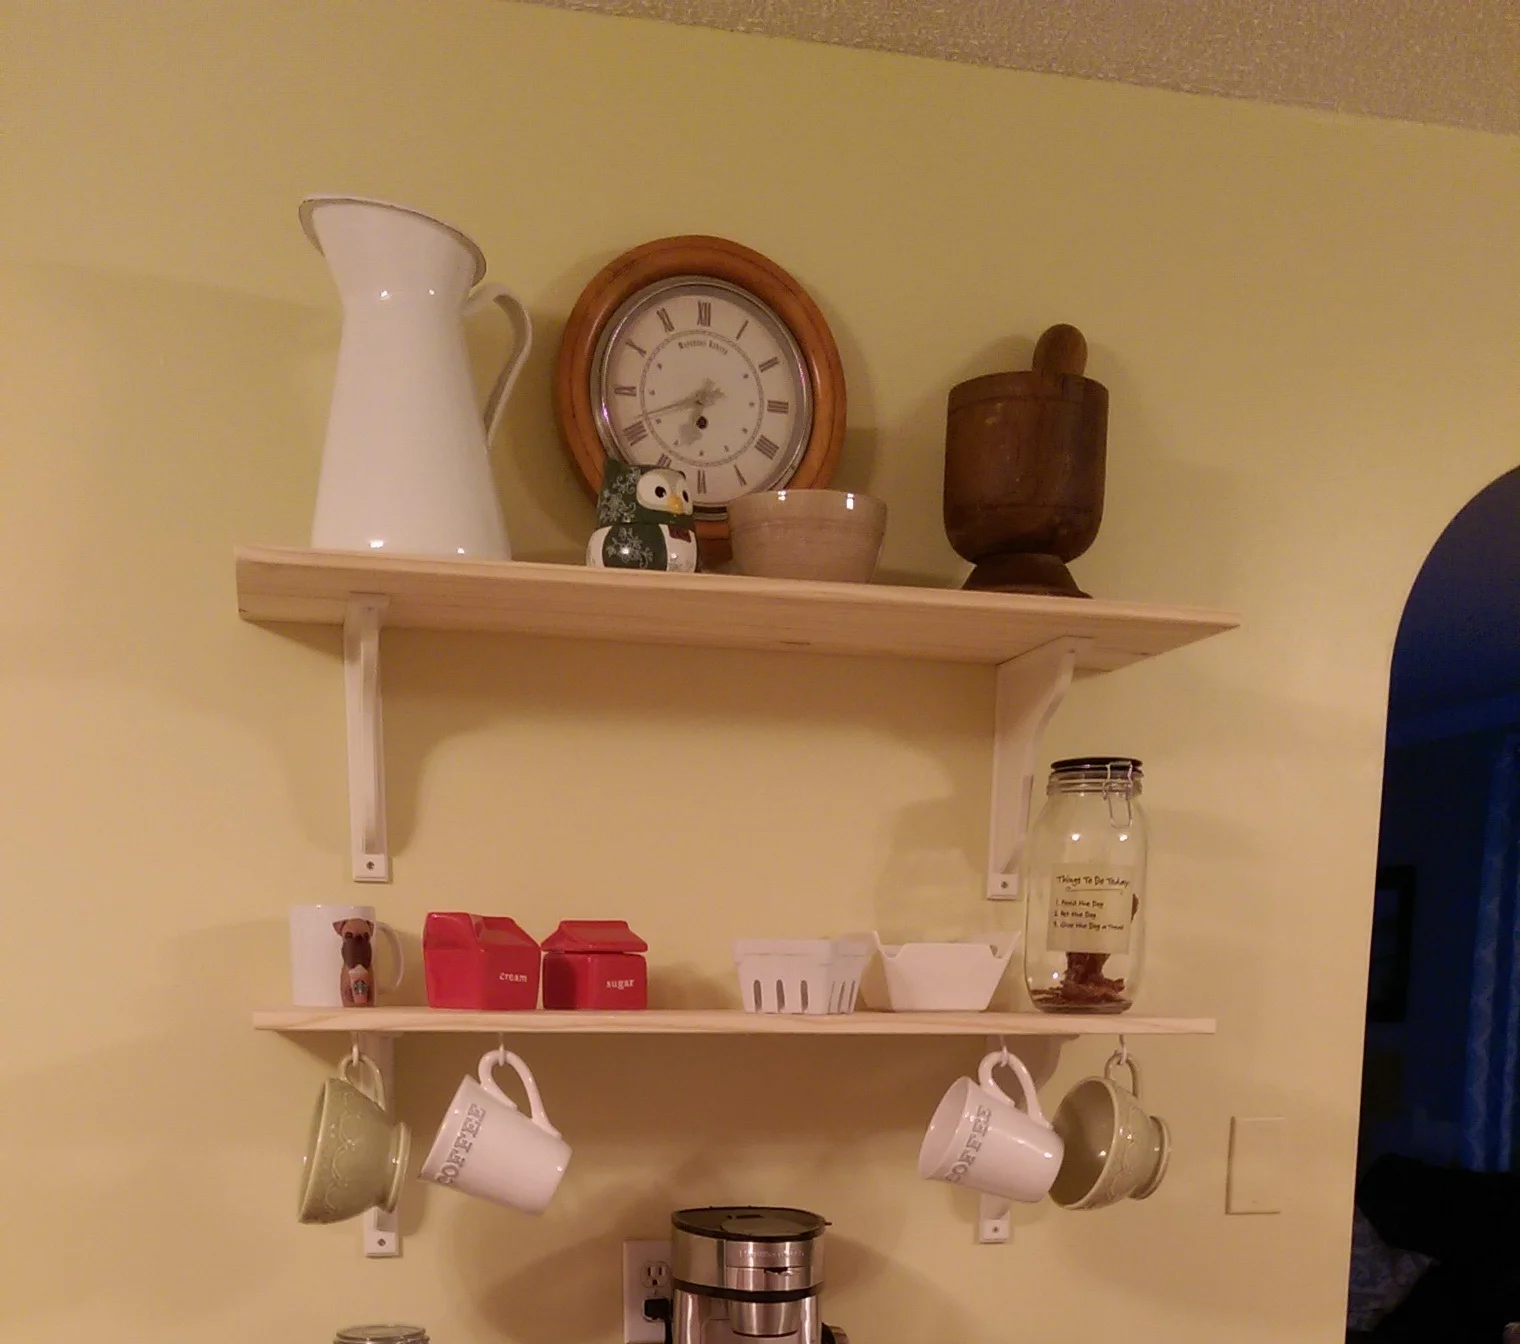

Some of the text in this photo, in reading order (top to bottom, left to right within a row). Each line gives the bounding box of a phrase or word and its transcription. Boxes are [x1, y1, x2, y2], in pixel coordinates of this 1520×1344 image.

[1056, 874, 1130, 889] Things To Do Today
[499, 972, 528, 983] cream
[606, 978, 635, 990] sugar
